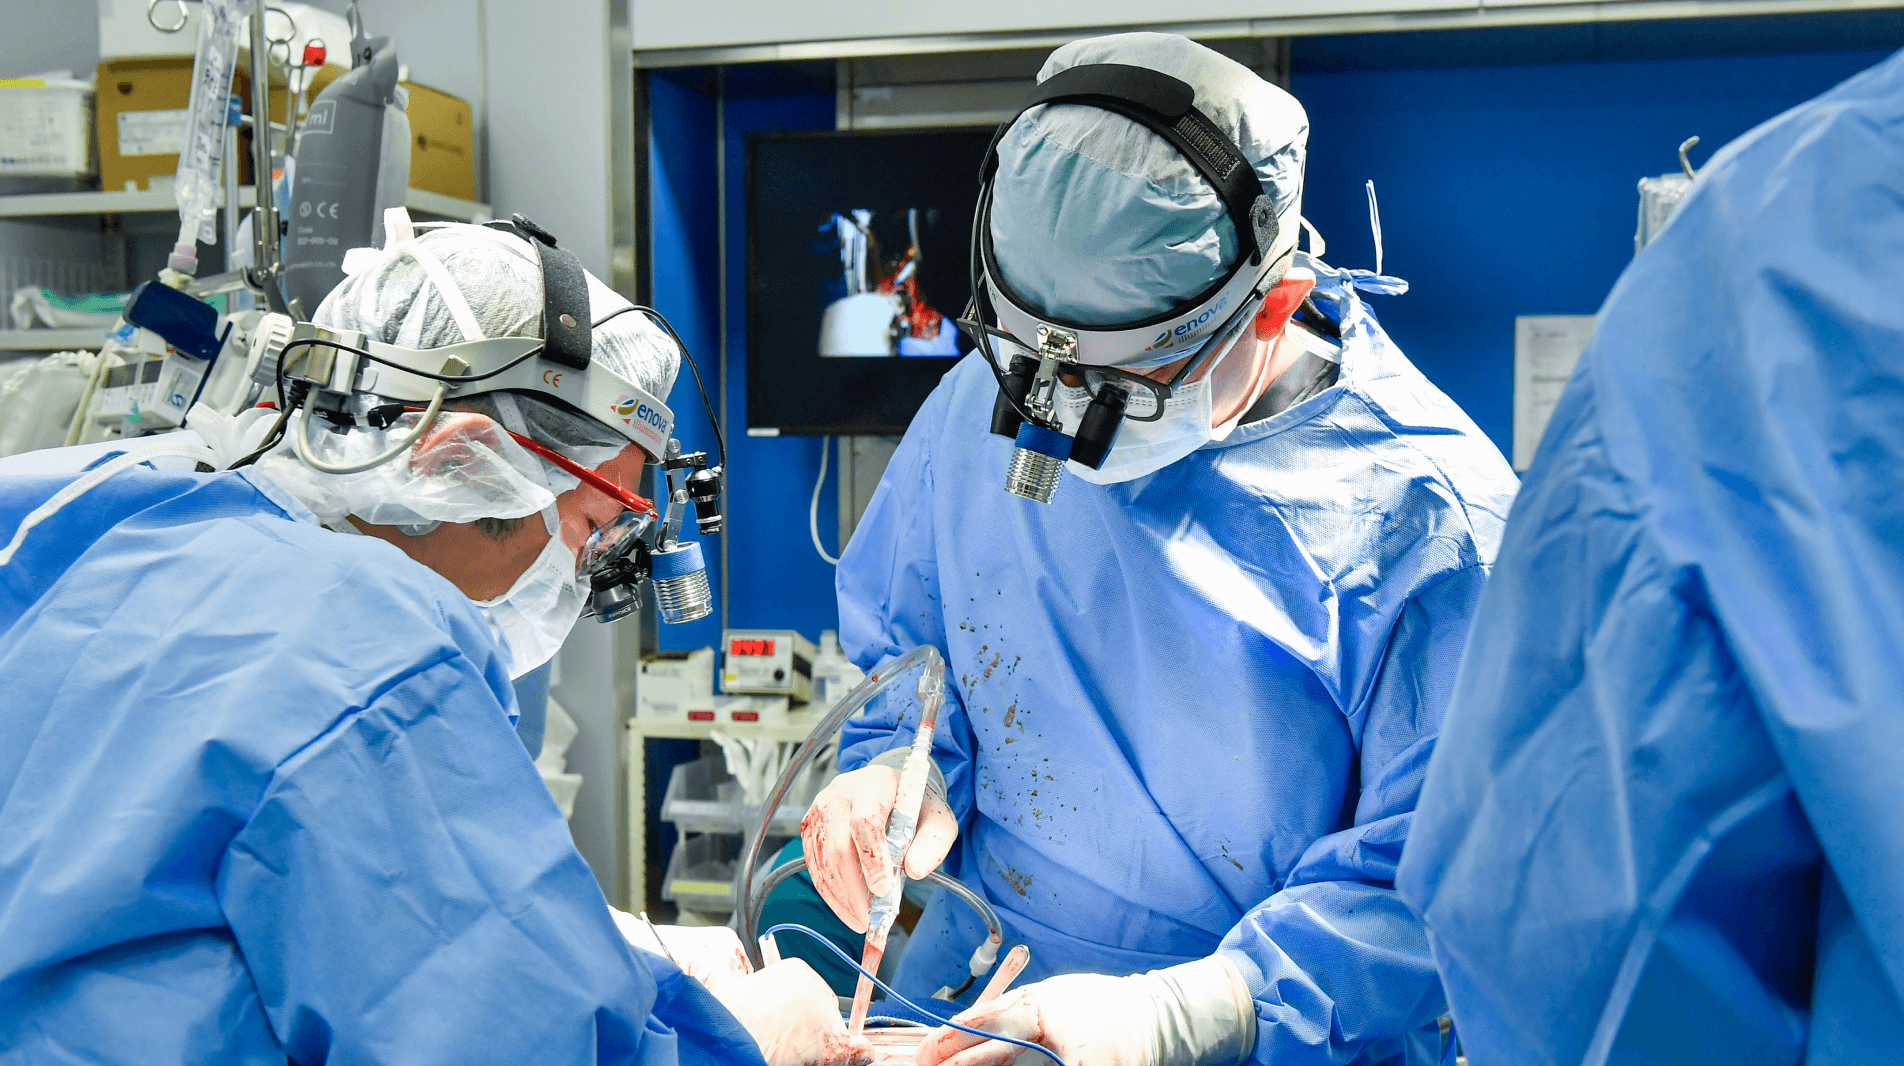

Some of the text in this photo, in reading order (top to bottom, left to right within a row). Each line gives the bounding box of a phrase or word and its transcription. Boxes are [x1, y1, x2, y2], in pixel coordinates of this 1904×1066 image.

[309, 109, 328, 125] ml
[316, 201, 339, 219] CE
[1174, 297, 1227, 336] enova
[543, 369, 563, 388] CE
[637, 403, 667, 434] enova
